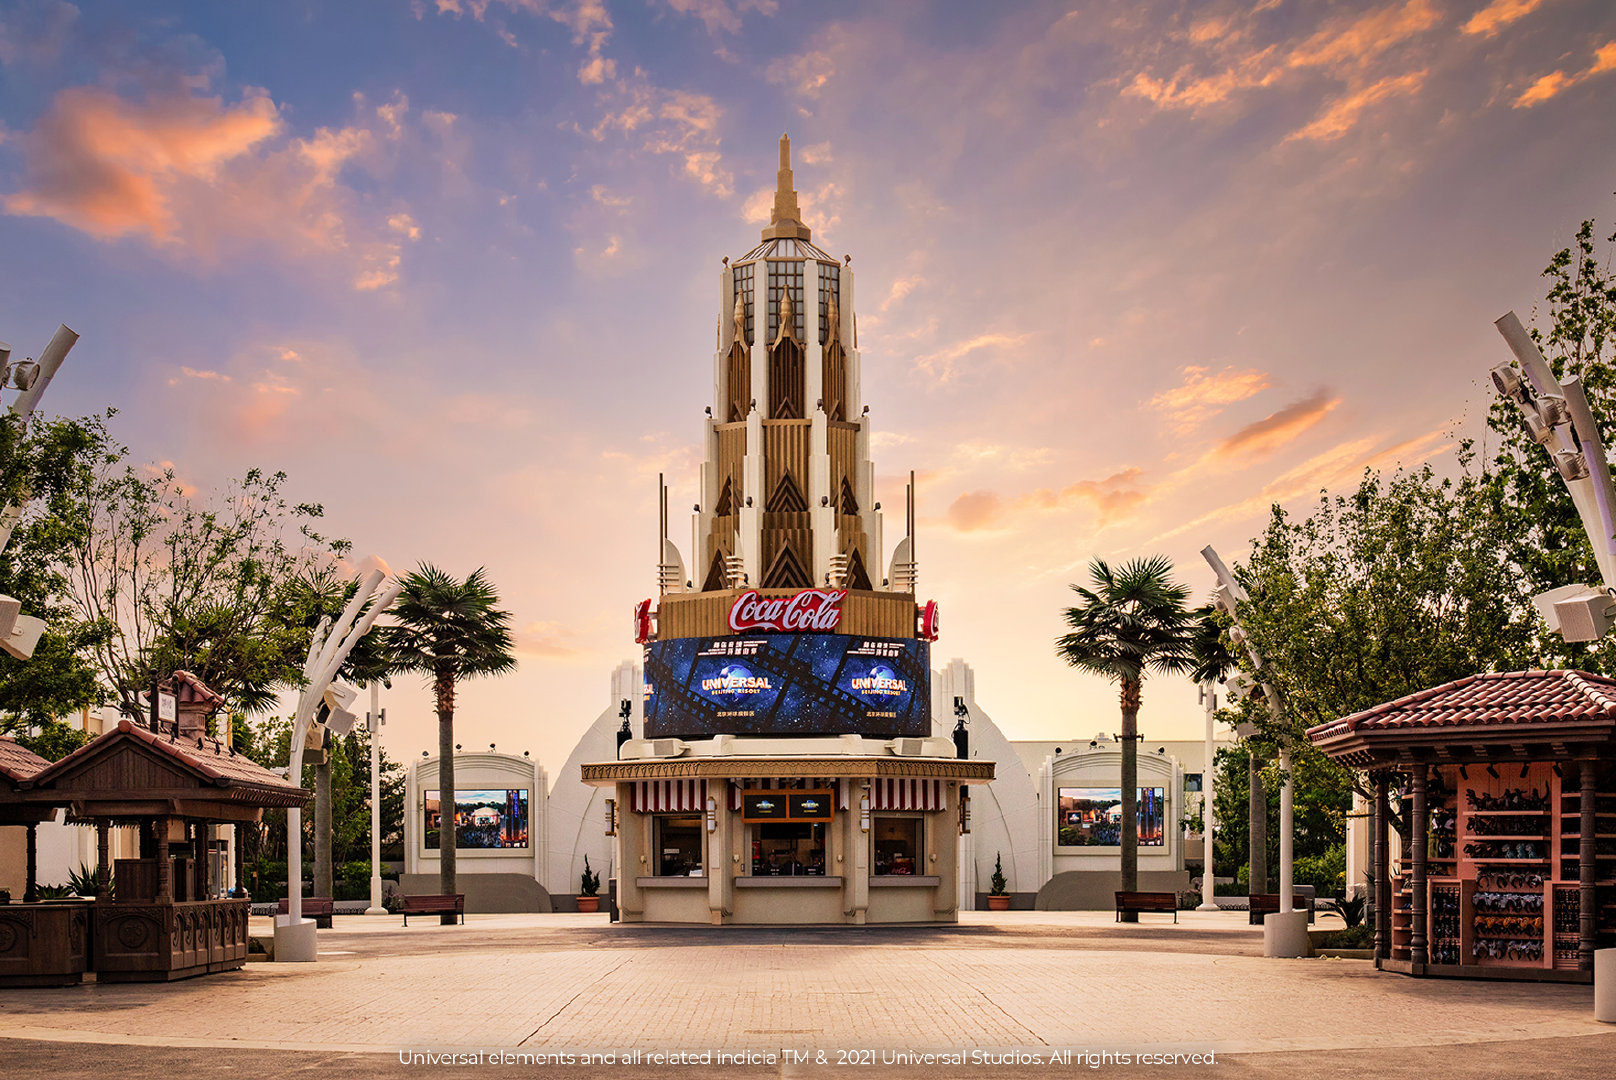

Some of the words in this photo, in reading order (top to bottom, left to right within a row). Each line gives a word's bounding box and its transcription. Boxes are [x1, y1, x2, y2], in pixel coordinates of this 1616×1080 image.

[729, 589, 847, 631] Coca-Cola
[702, 677, 772, 691] UNIVERSAL
[851, 677, 908, 691] UNIVERSAL
